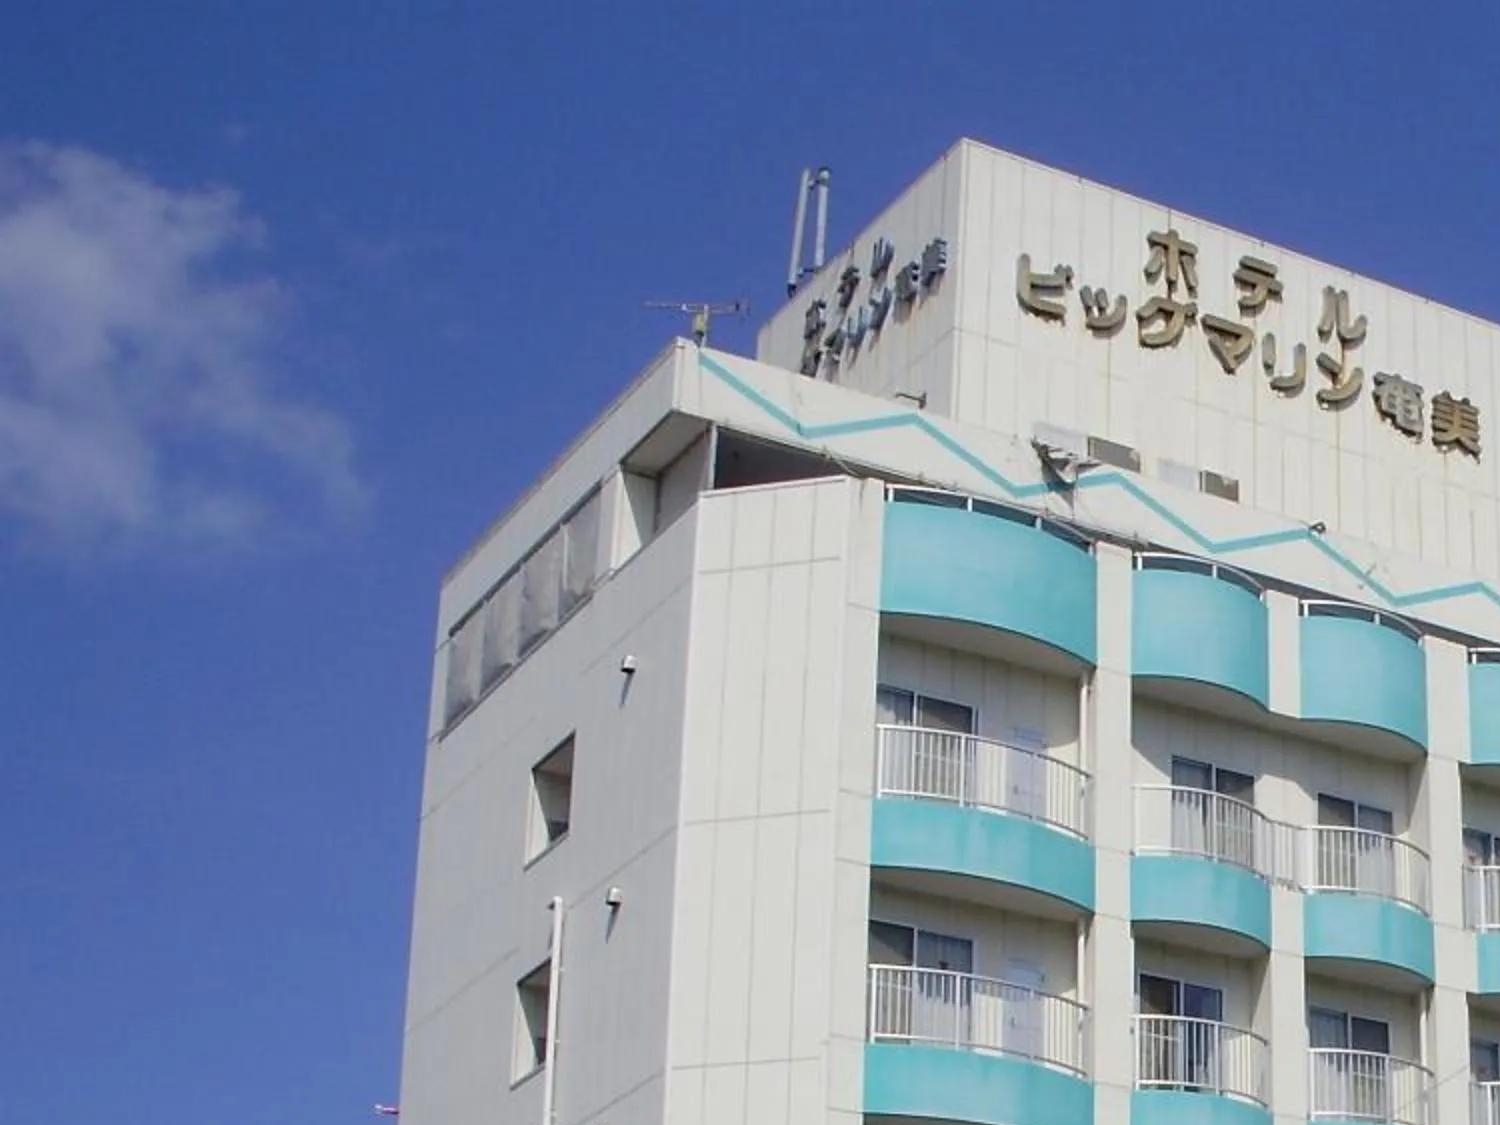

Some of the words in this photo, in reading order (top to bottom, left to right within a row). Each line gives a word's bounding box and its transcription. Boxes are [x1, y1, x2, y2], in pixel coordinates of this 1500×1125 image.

[1015, 252, 1481, 464] ビッグマリン奄美
[1142, 228, 1368, 348] ホテル
